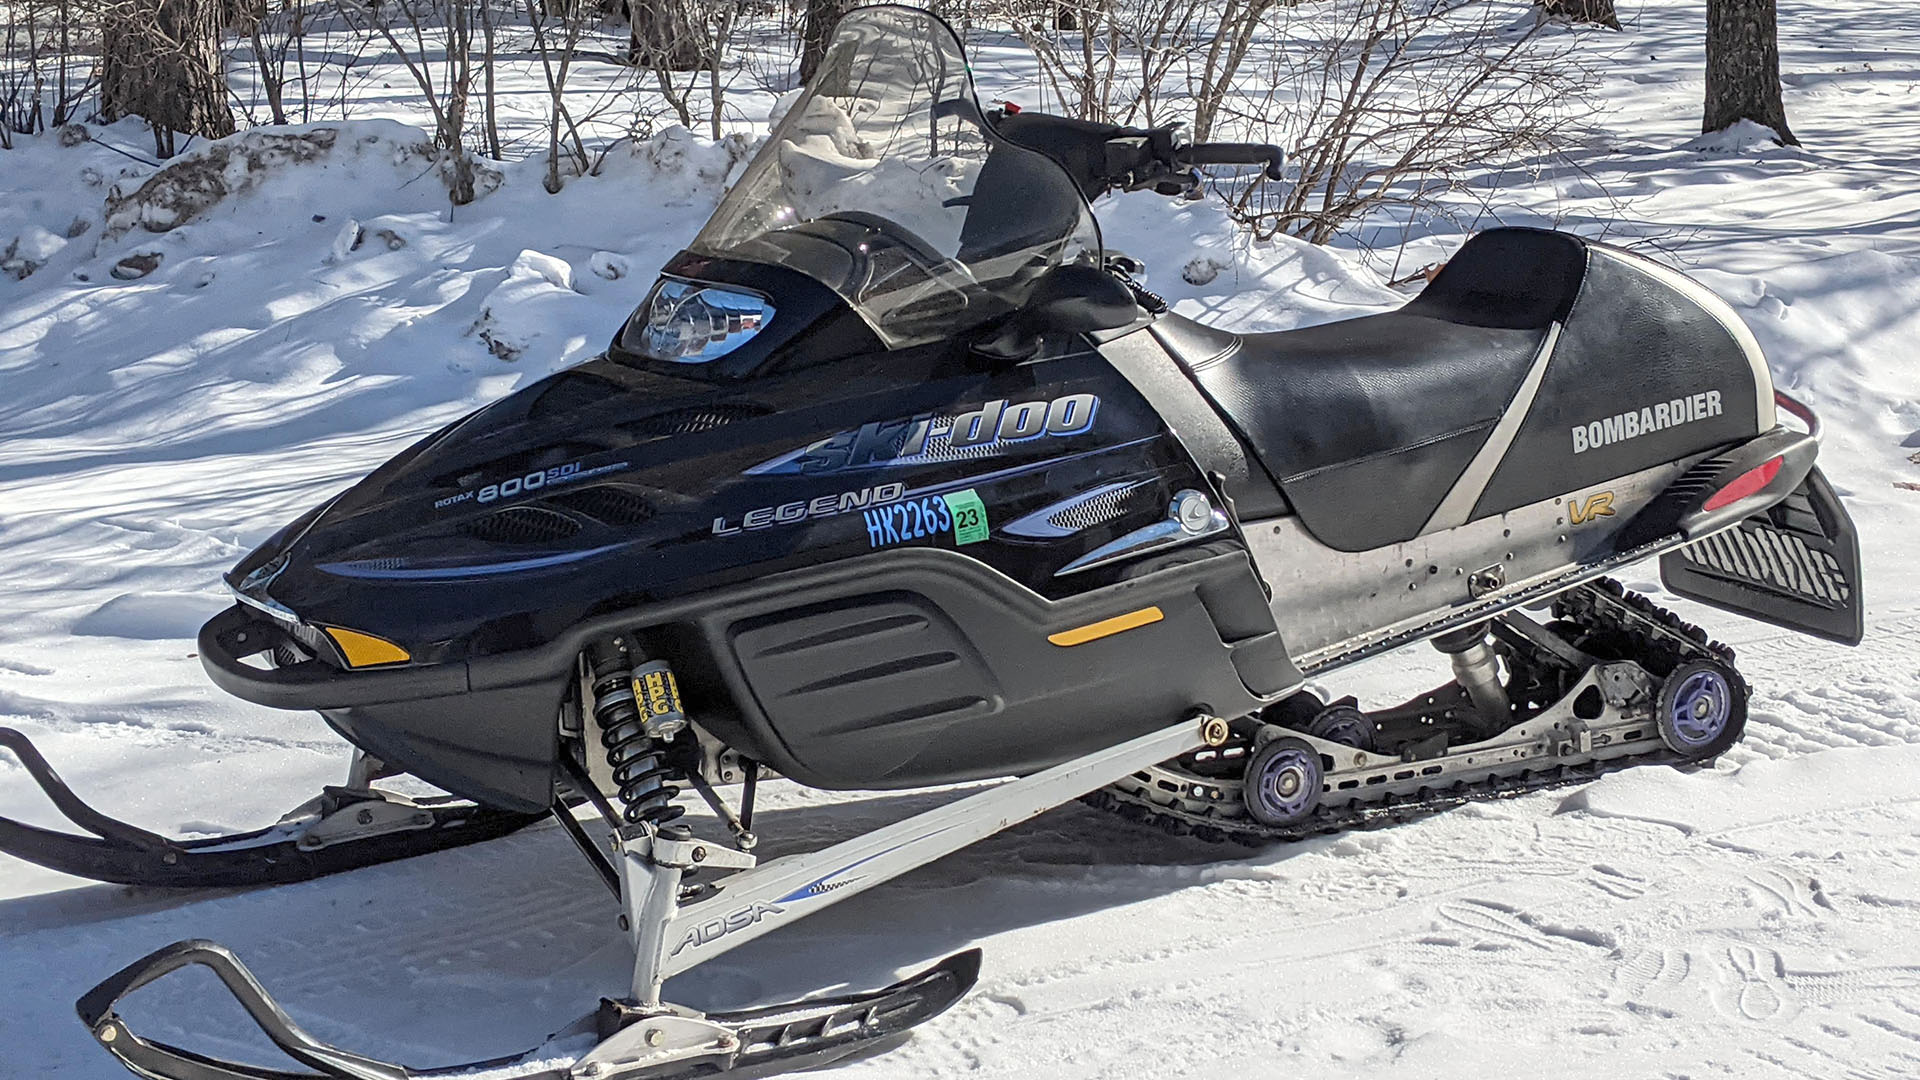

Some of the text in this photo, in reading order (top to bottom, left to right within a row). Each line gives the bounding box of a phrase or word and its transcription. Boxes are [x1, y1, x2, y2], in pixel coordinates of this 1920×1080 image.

[1572, 390, 1723, 454] BOMBARDIER
[435, 490, 474, 509] ROTAX
[477, 470, 545, 503] 800
[711, 482, 906, 537] LEGEND
[1568, 491, 1616, 525] VR
[863, 495, 950, 547] HK2263
[956, 509, 979, 529] 23
[645, 672, 669, 715] HPG
[670, 899, 785, 957] ADSA
